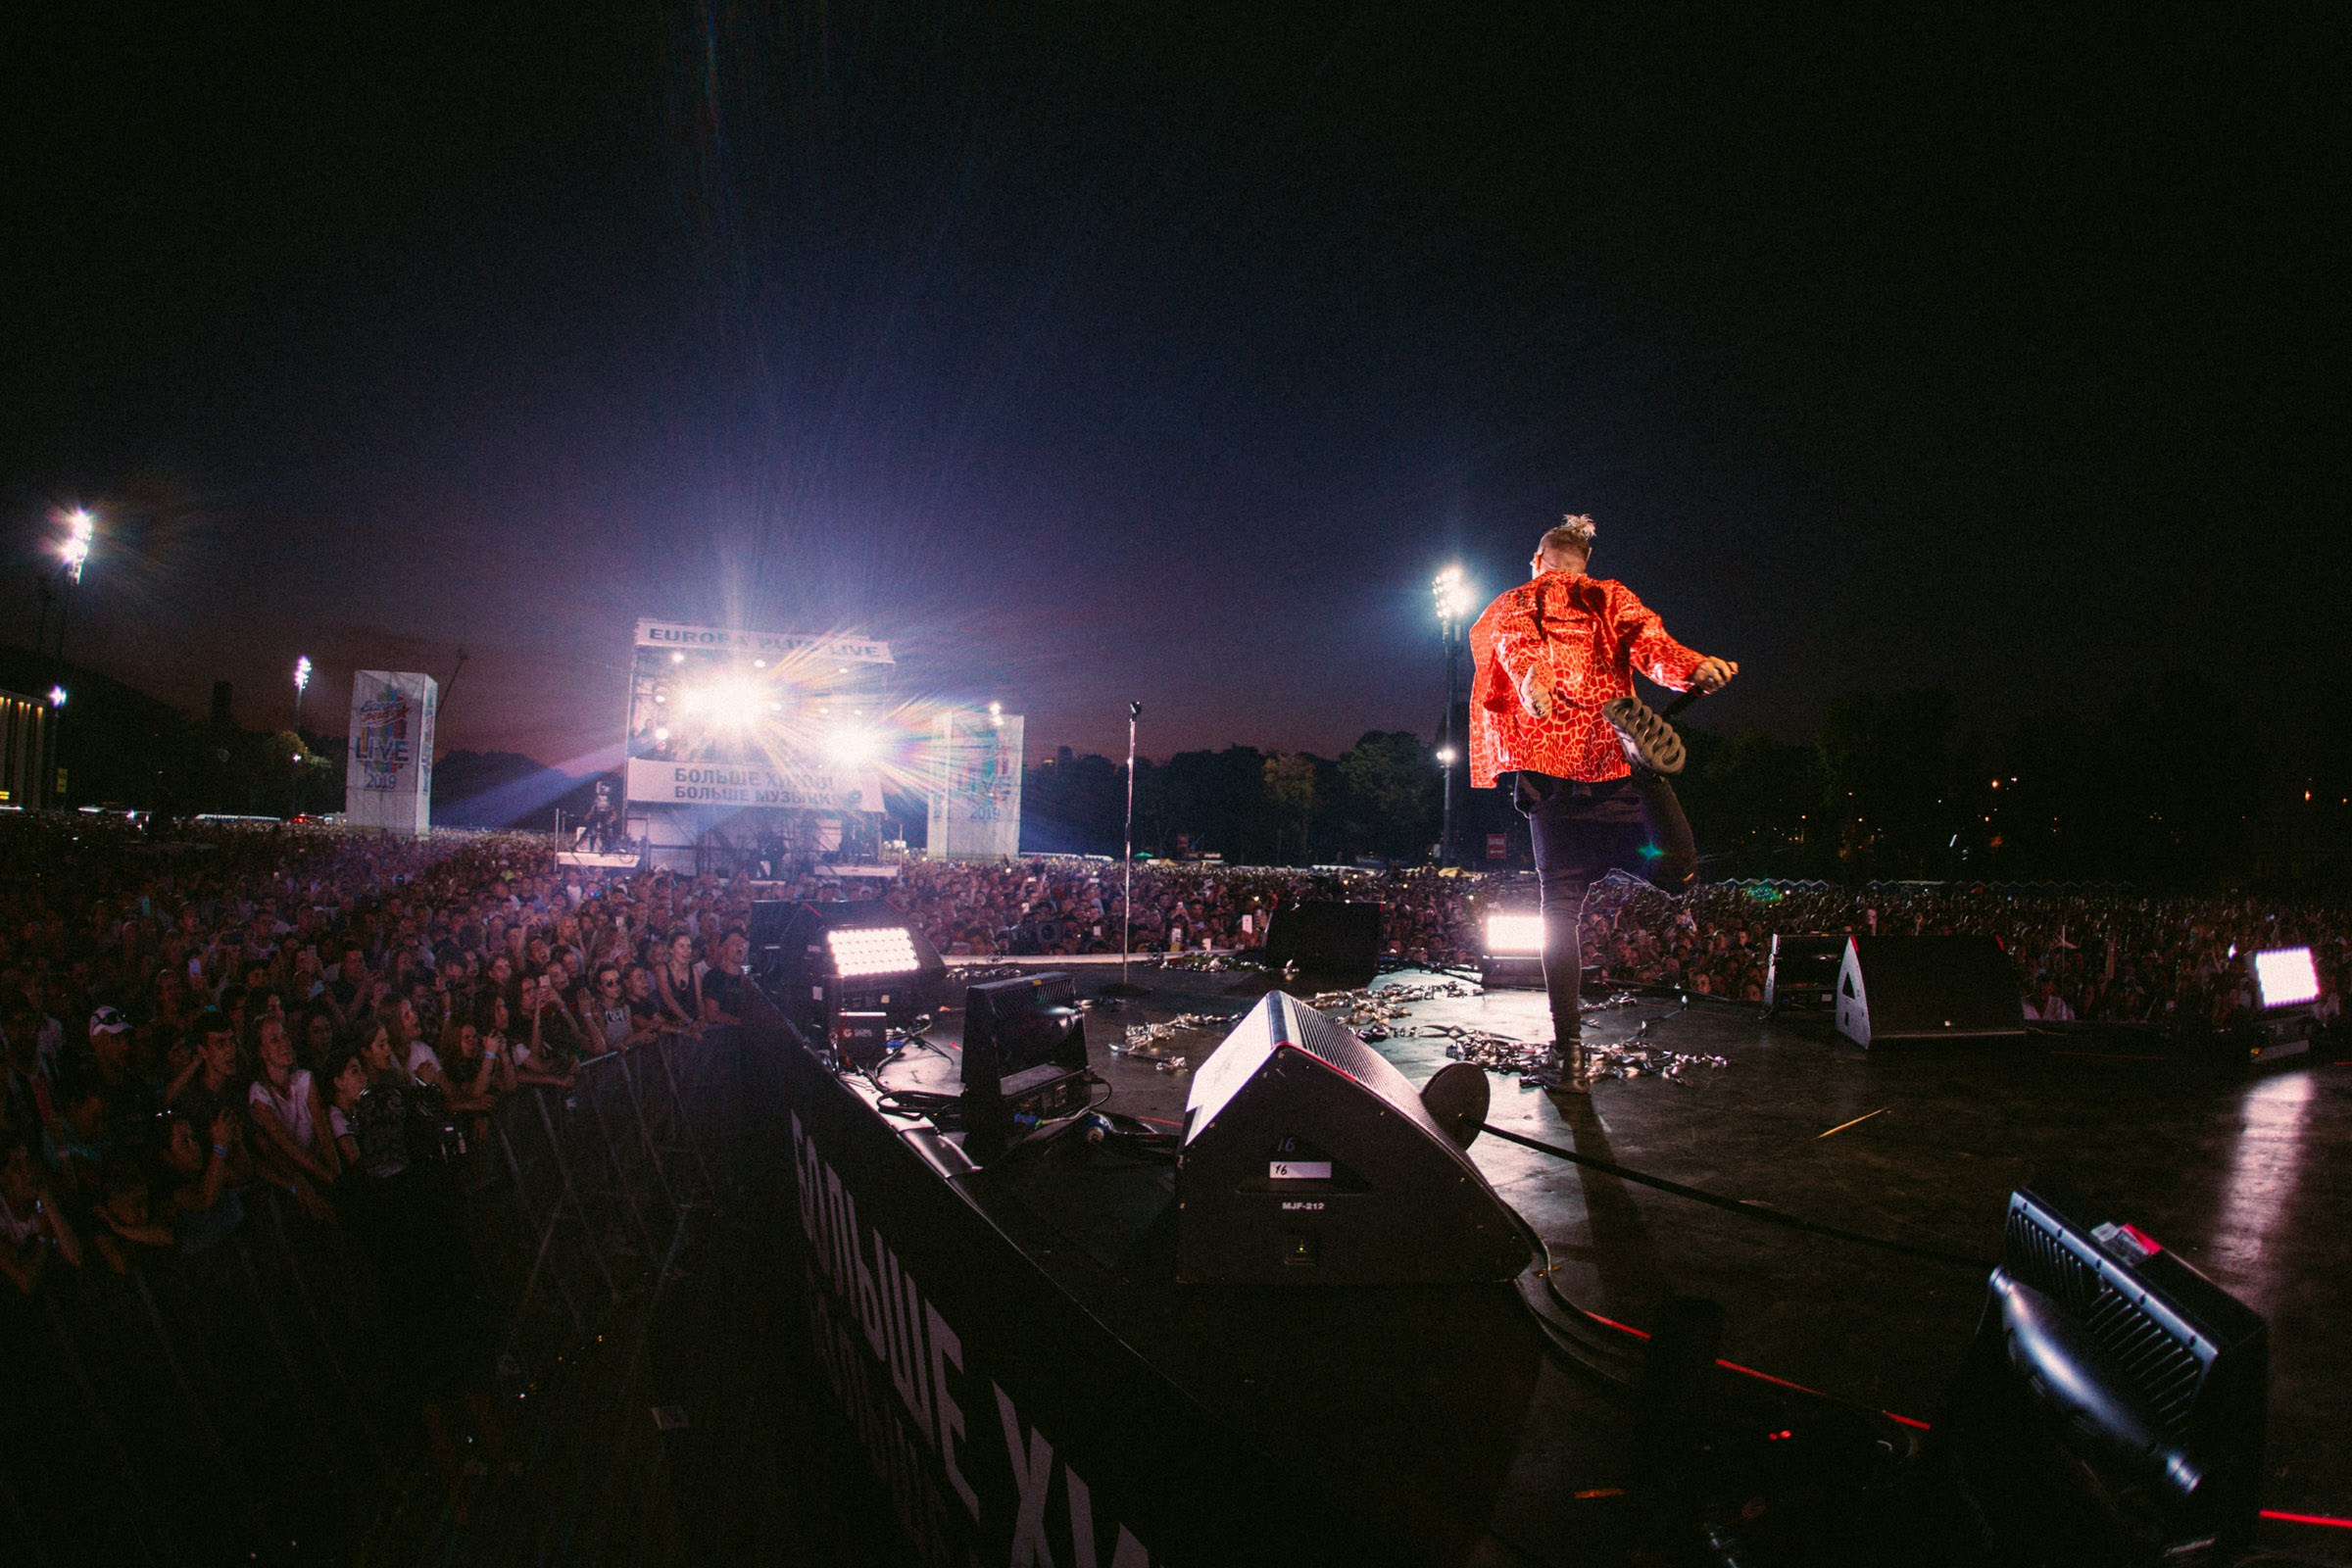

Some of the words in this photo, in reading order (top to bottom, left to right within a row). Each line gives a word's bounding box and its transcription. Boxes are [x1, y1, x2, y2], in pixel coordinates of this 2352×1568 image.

[356, 736, 409, 761] LIVE
[366, 770, 397, 790] 2019
[674, 767, 760, 786] БОЛЬШЕ
[674, 785, 751, 801] БОЛЬШЕ
[970, 806, 1001, 820] 2019
[1278, 1138, 1295, 1152] 16
[1276, 1164, 1287, 1175] 16
[1282, 1201, 1324, 1210] MJF-212
